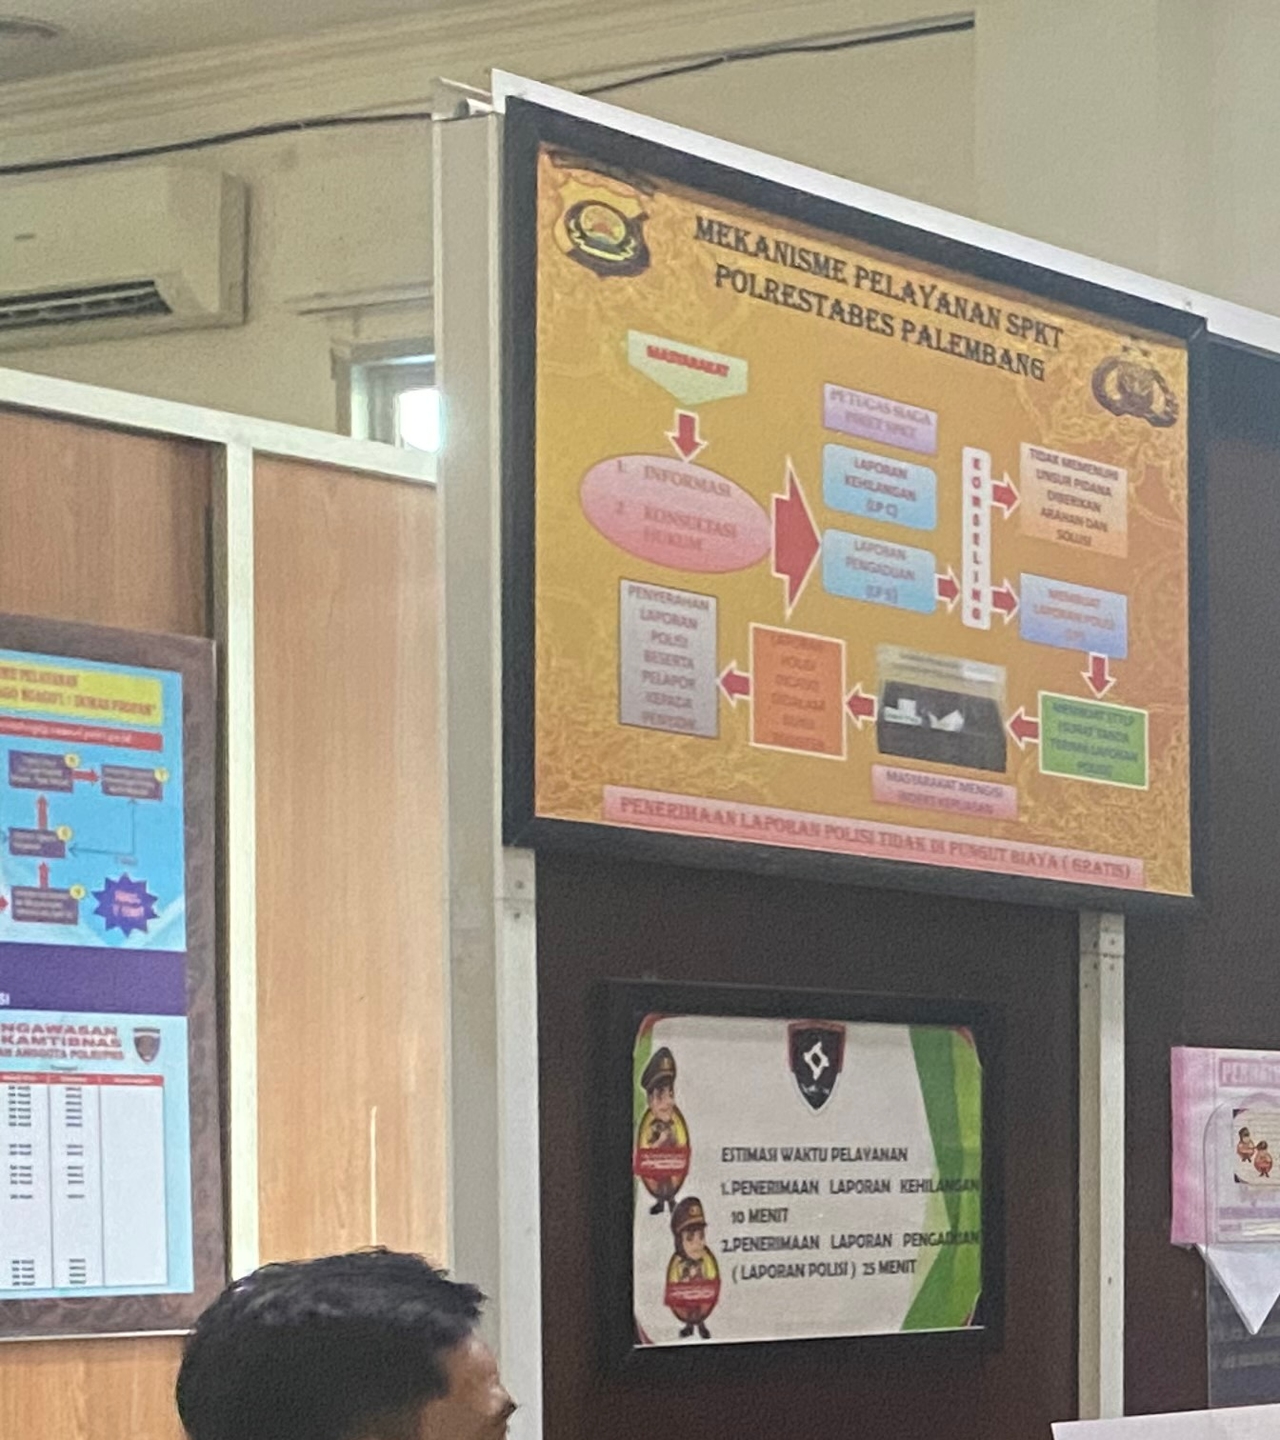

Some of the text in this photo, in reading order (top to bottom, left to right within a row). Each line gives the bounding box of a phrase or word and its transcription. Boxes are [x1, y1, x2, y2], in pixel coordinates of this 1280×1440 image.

[694, 215, 1064, 350] MEKANISME PELAYANAN SPKT
[715, 262, 1045, 381] POLRESTABES PALEMBANG
[1029, 448, 1059, 465] TIDAK
[855, 457, 908, 480] LAPORAN
[644, 465, 732, 497] INFORMASI
[844, 475, 916, 501] KEHILANGAN
[1036, 468, 1112, 497] UNSUR PIDANA
[640, 609, 698, 630] LAPORAN
[886, 771, 957, 791] MASYARAKAT
[958, 781, 1004, 799] MENGISI
[620, 796, 736, 827] PENERIMAAN
[741, 812, 821, 838] LAPORAN
[825, 824, 875, 844] POLISI
[880, 831, 929, 852] TIDAK
[950, 841, 1007, 861] PUNGUT
[1011, 849, 1058, 871] BIAYA
[721, 1146, 908, 1163] ESTIMASI WAKTU PELAYANAN
[830, 1178, 891, 1195] LAPORAN
[900, 1177, 979, 1194] KEHILANGAN
[731, 1207, 789, 1224] 10 MENIT
[831, 1232, 892, 1249] LAPORAN
[902, 1230, 980, 1248] PENGADUAN
[741, 1262, 805, 1280] LAPORAN
[808, 1260, 848, 1278] POLISI
[878, 1258, 917, 1275] MENIT
